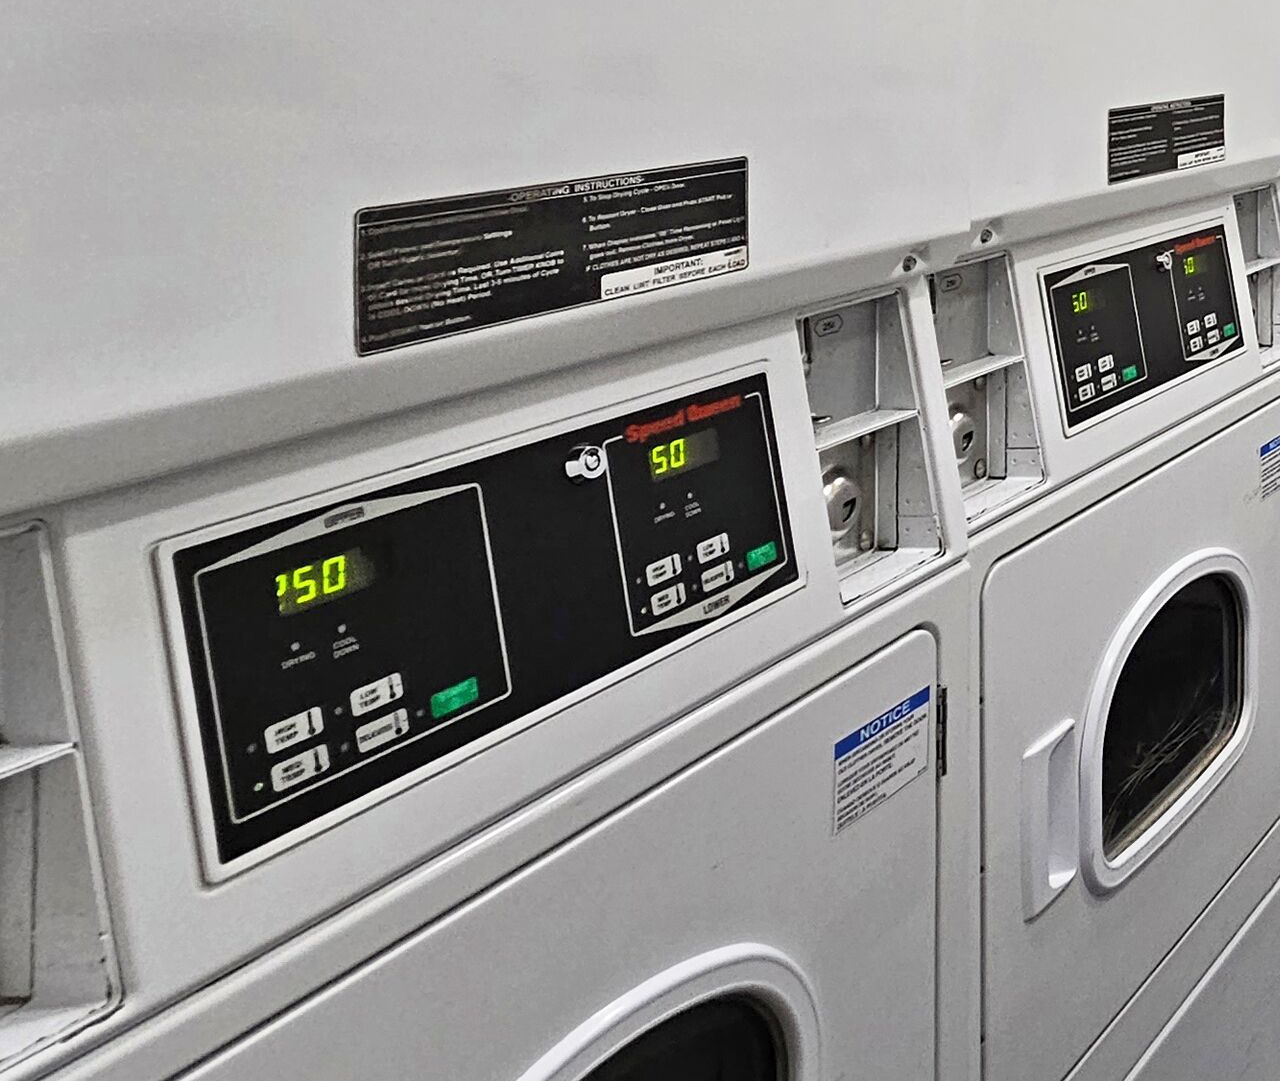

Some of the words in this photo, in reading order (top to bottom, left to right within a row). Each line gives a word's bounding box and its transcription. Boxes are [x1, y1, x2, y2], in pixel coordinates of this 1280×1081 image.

[604, 285, 630, 297] CLEAN
[653, 274, 676, 285] FILTER
[679, 267, 706, 279] BEFORE
[708, 264, 726, 273] EACH
[728, 259, 745, 269] LOAD
[654, 258, 703, 275] IMPORTANT:
[652, 438, 686, 475] 50
[702, 596, 730, 615] LOWER
[859, 699, 911, 742] NOTICE
